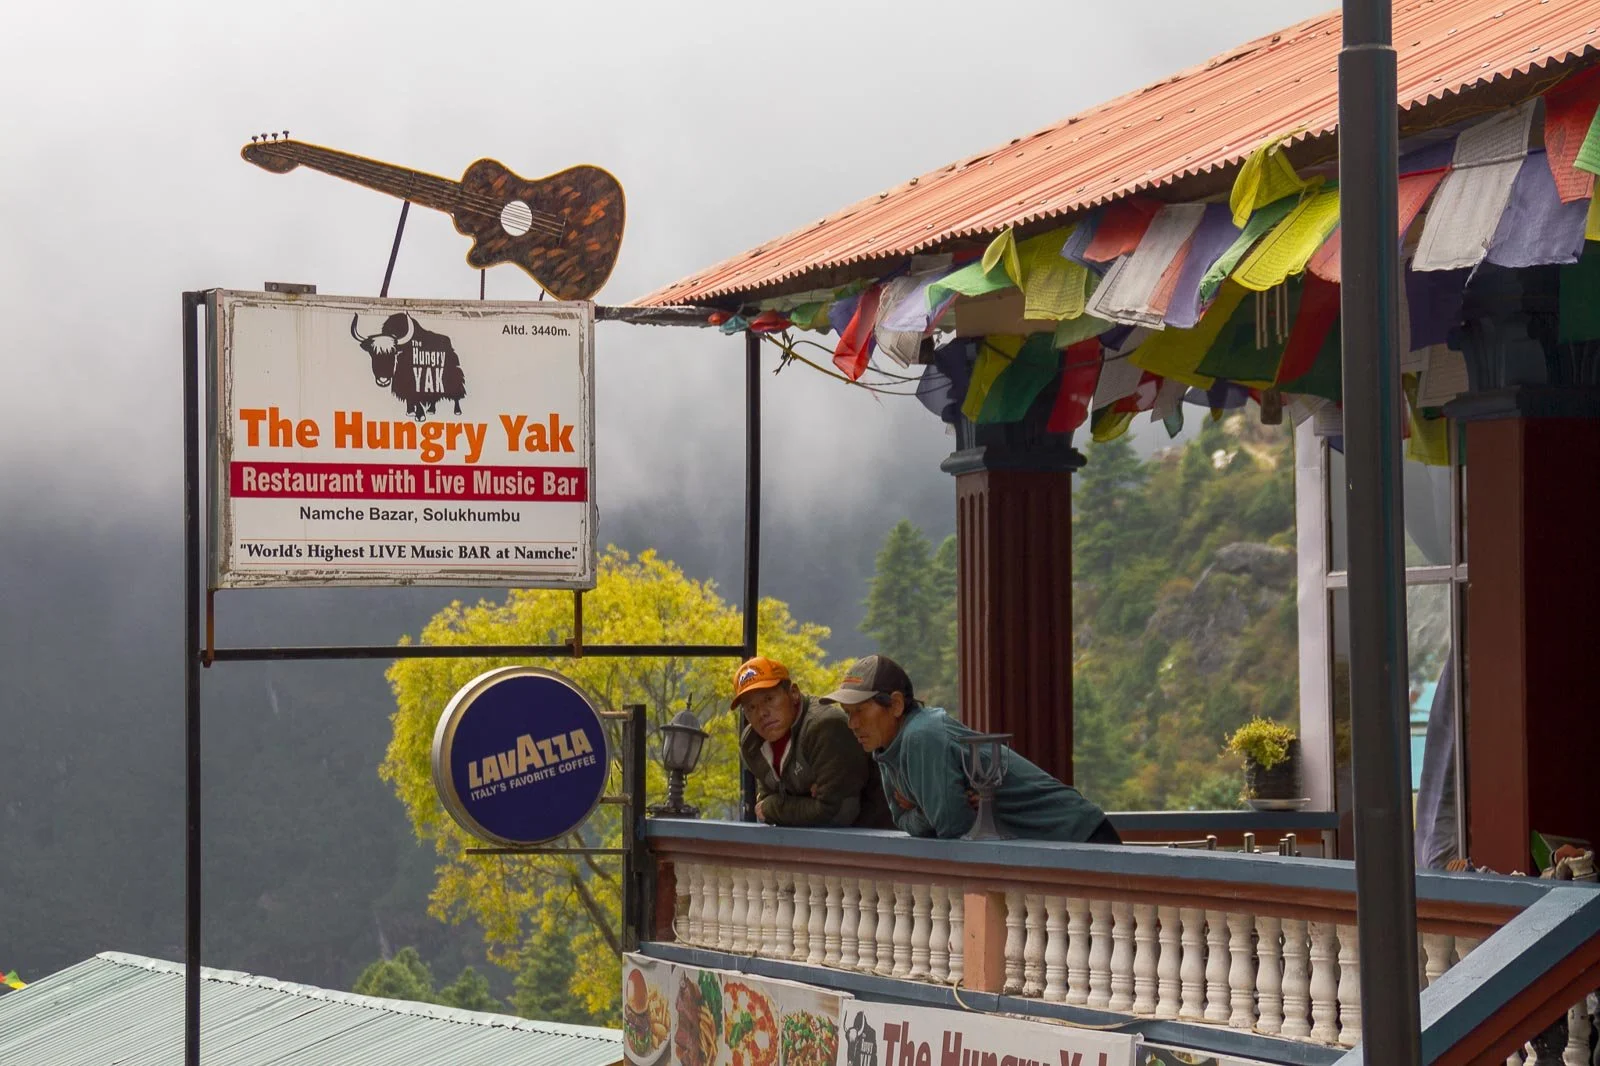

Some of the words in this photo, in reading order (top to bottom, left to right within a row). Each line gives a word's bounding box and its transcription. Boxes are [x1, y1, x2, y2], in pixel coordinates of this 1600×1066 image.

[502, 325, 527, 335] Altd.
[532, 325, 570, 336] 3440m.
[412, 347, 446, 367] Hungry
[412, 367, 445, 392] YAK
[240, 407, 320, 448] The
[334, 411, 488, 463] Hungry
[499, 413, 575, 452] Yak
[242, 467, 364, 492] Restaurant
[371, 469, 416, 494] with
[424, 470, 465, 494] Live
[473, 470, 535, 495] Music
[543, 471, 578, 496] Bar
[300, 506, 364, 520] Namche
[369, 507, 418, 523] Bazar,
[423, 507, 520, 522] Solukhumbu
[240, 544, 303, 558] "World's
[307, 545, 364, 561] Highest
[369, 545, 406, 558] LIVE
[411, 545, 454, 558] Music
[458, 546, 491, 559] BAR
[496, 547, 509, 559] at
[514, 546, 578, 560] Namche."
[471, 782, 507, 801] ITALY'S
[509, 767, 556, 789] FAVORITE
[558, 754, 596, 774] COFFEE
